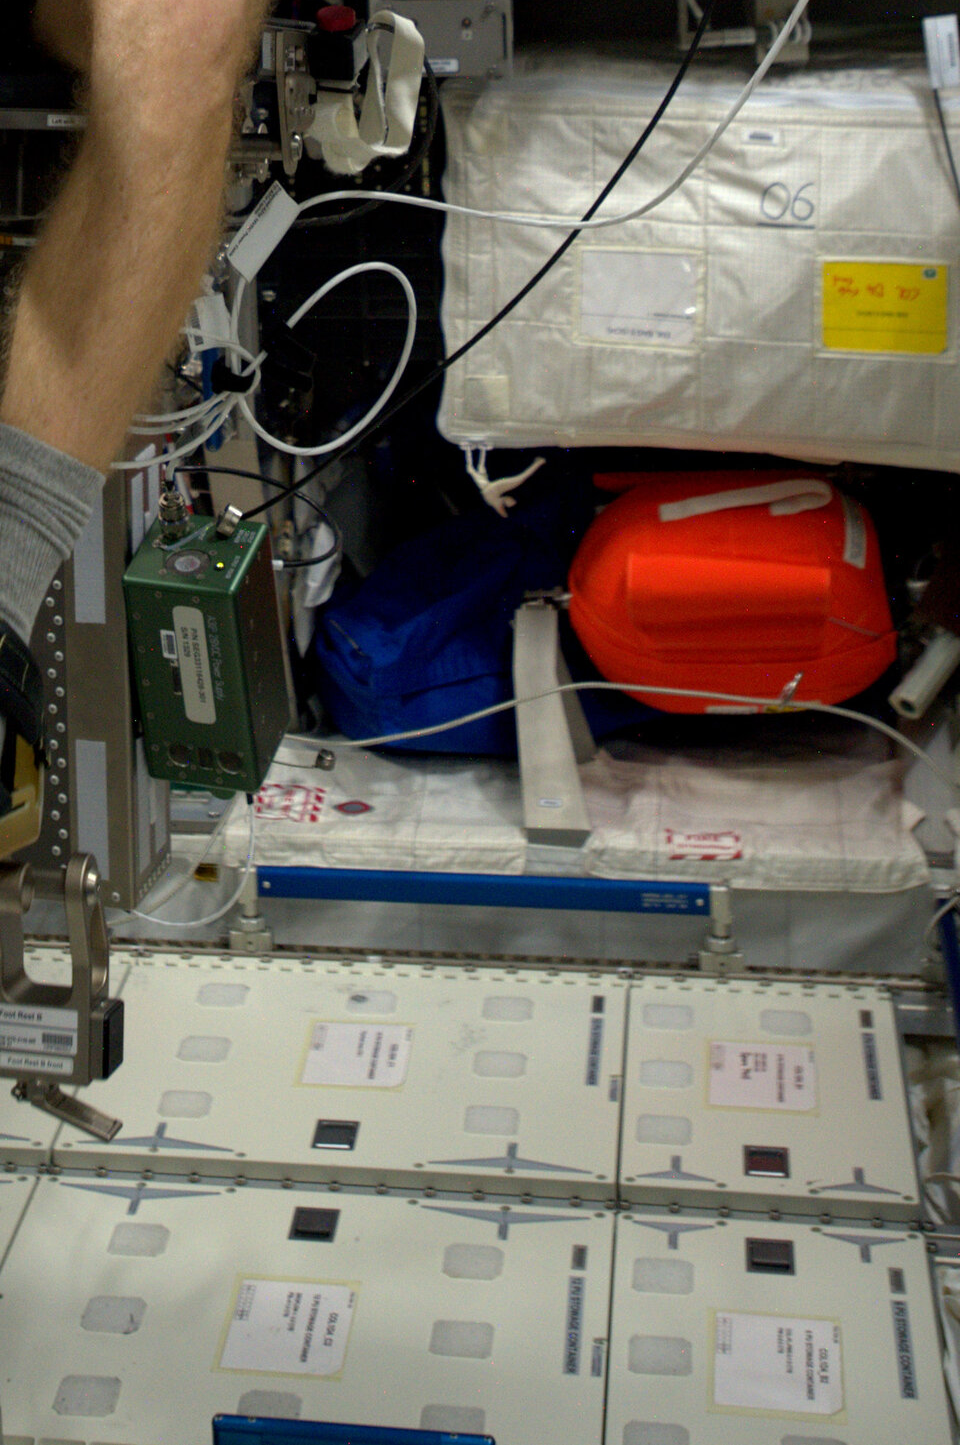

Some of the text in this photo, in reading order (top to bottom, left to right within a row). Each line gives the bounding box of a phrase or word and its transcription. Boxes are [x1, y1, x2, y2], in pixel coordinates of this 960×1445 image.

[17, 1011, 34, 1020] Rest
[7, 1057, 23, 1065] Foot
[23, 1058, 39, 1067] Rest
[46, 1060, 64, 1069] front
[571, 1286, 582, 1296] PU
[568, 1296, 581, 1331] STOWAGE
[894, 1305, 906, 1317] PU
[896, 1318, 911, 1354] STOWAGE
[566, 1332, 578, 1374] CONTAINER
[899, 1355, 916, 1399] CONTAINER
